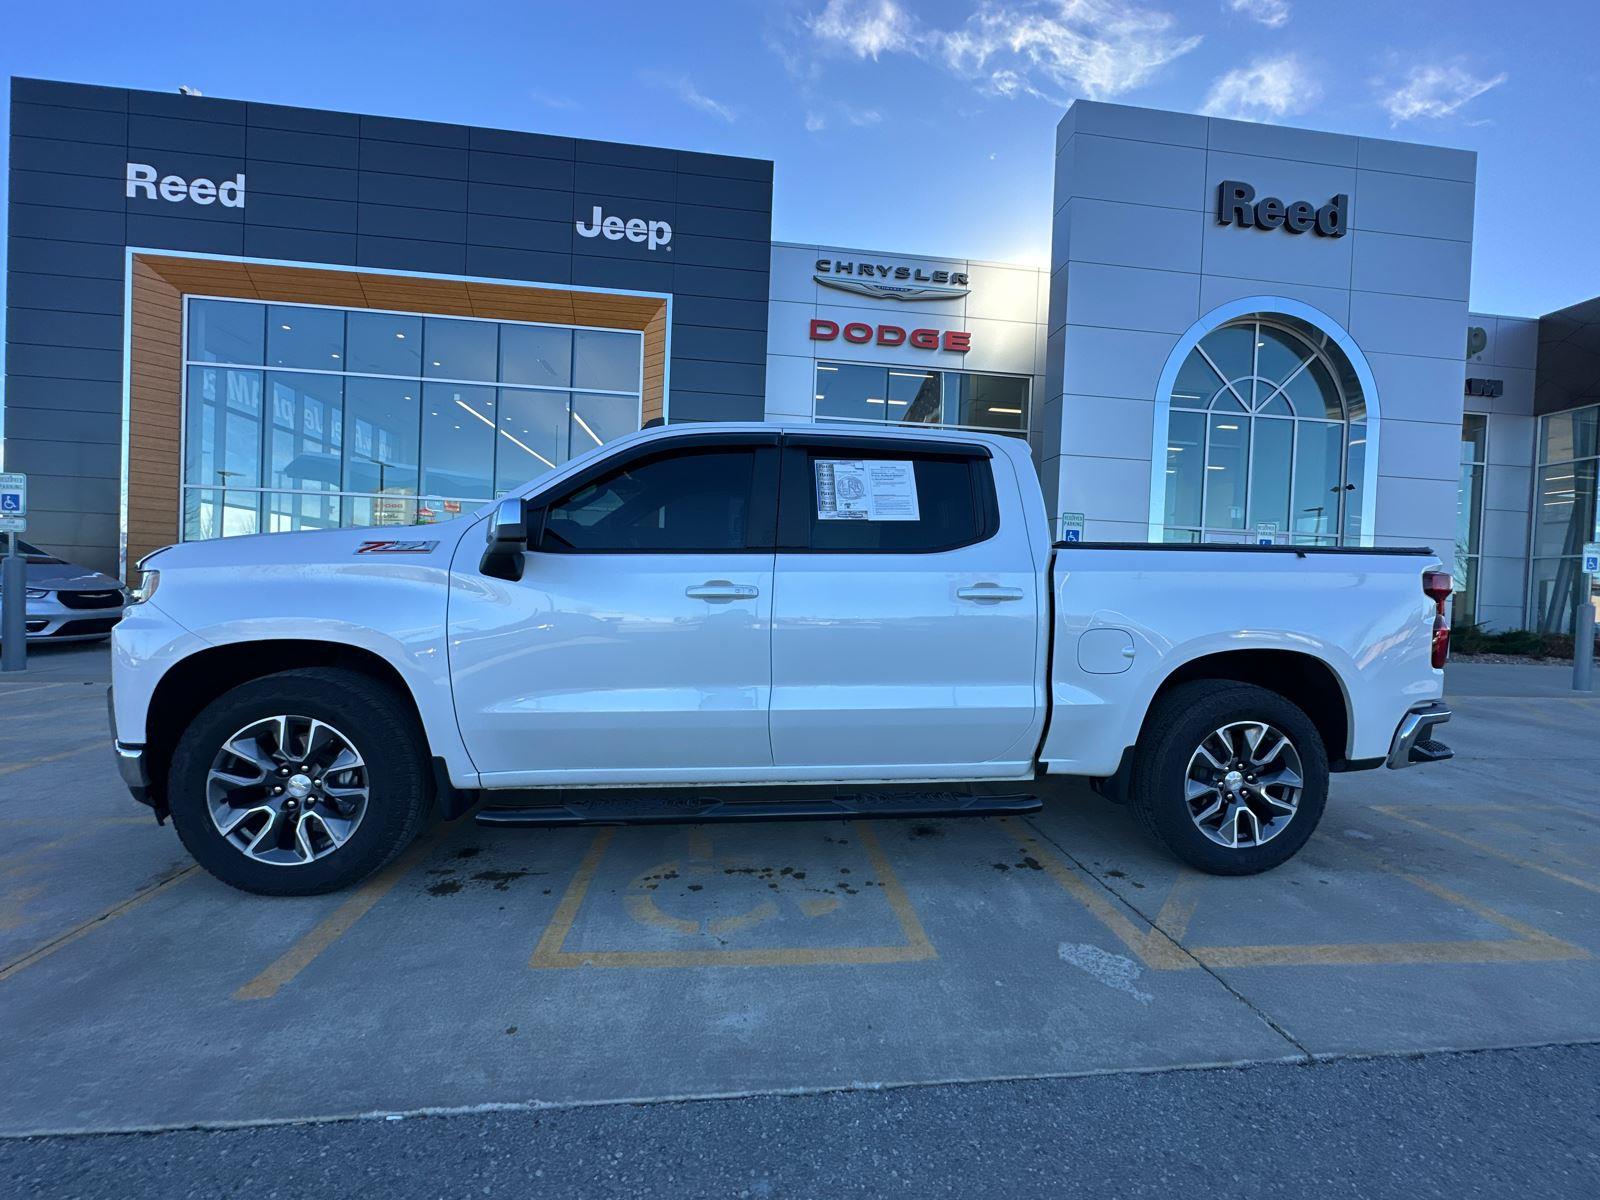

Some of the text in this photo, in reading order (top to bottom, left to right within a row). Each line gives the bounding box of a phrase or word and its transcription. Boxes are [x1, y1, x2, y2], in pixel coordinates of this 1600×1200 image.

[126, 163, 245, 208] Reed
[576, 206, 672, 250] Jeep
[1218, 180, 1348, 238] Reed
[815, 259, 969, 285] CHRYSLER
[809, 319, 971, 352] DODGE
